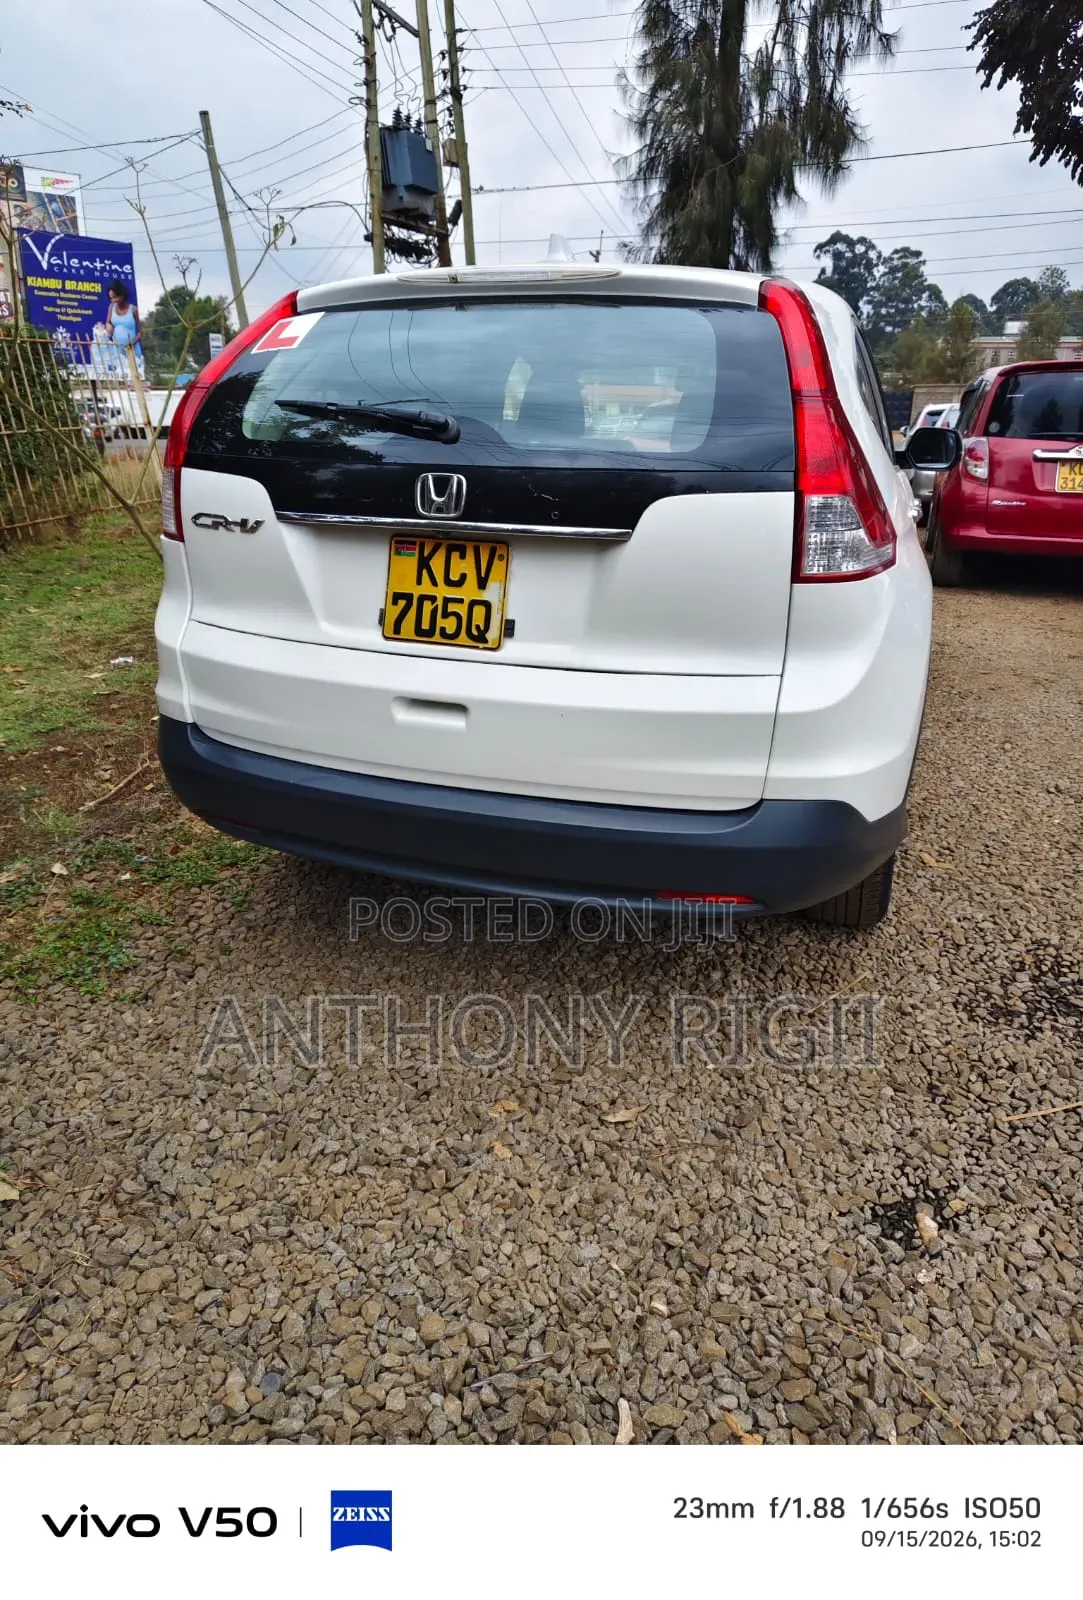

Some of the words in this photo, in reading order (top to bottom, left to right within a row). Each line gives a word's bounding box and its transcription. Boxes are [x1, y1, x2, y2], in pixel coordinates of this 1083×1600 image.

[22, 233, 132, 272] Valentine
[27, 276, 62, 289] KIAMBU
[65, 280, 102, 293] BRANCH
[54, 266, 85, 275] CAKE
[95, 271, 132, 280] HOUSE
[190, 511, 266, 534] CR-V
[415, 540, 498, 591] KCV
[391, 591, 493, 645] 705Q
